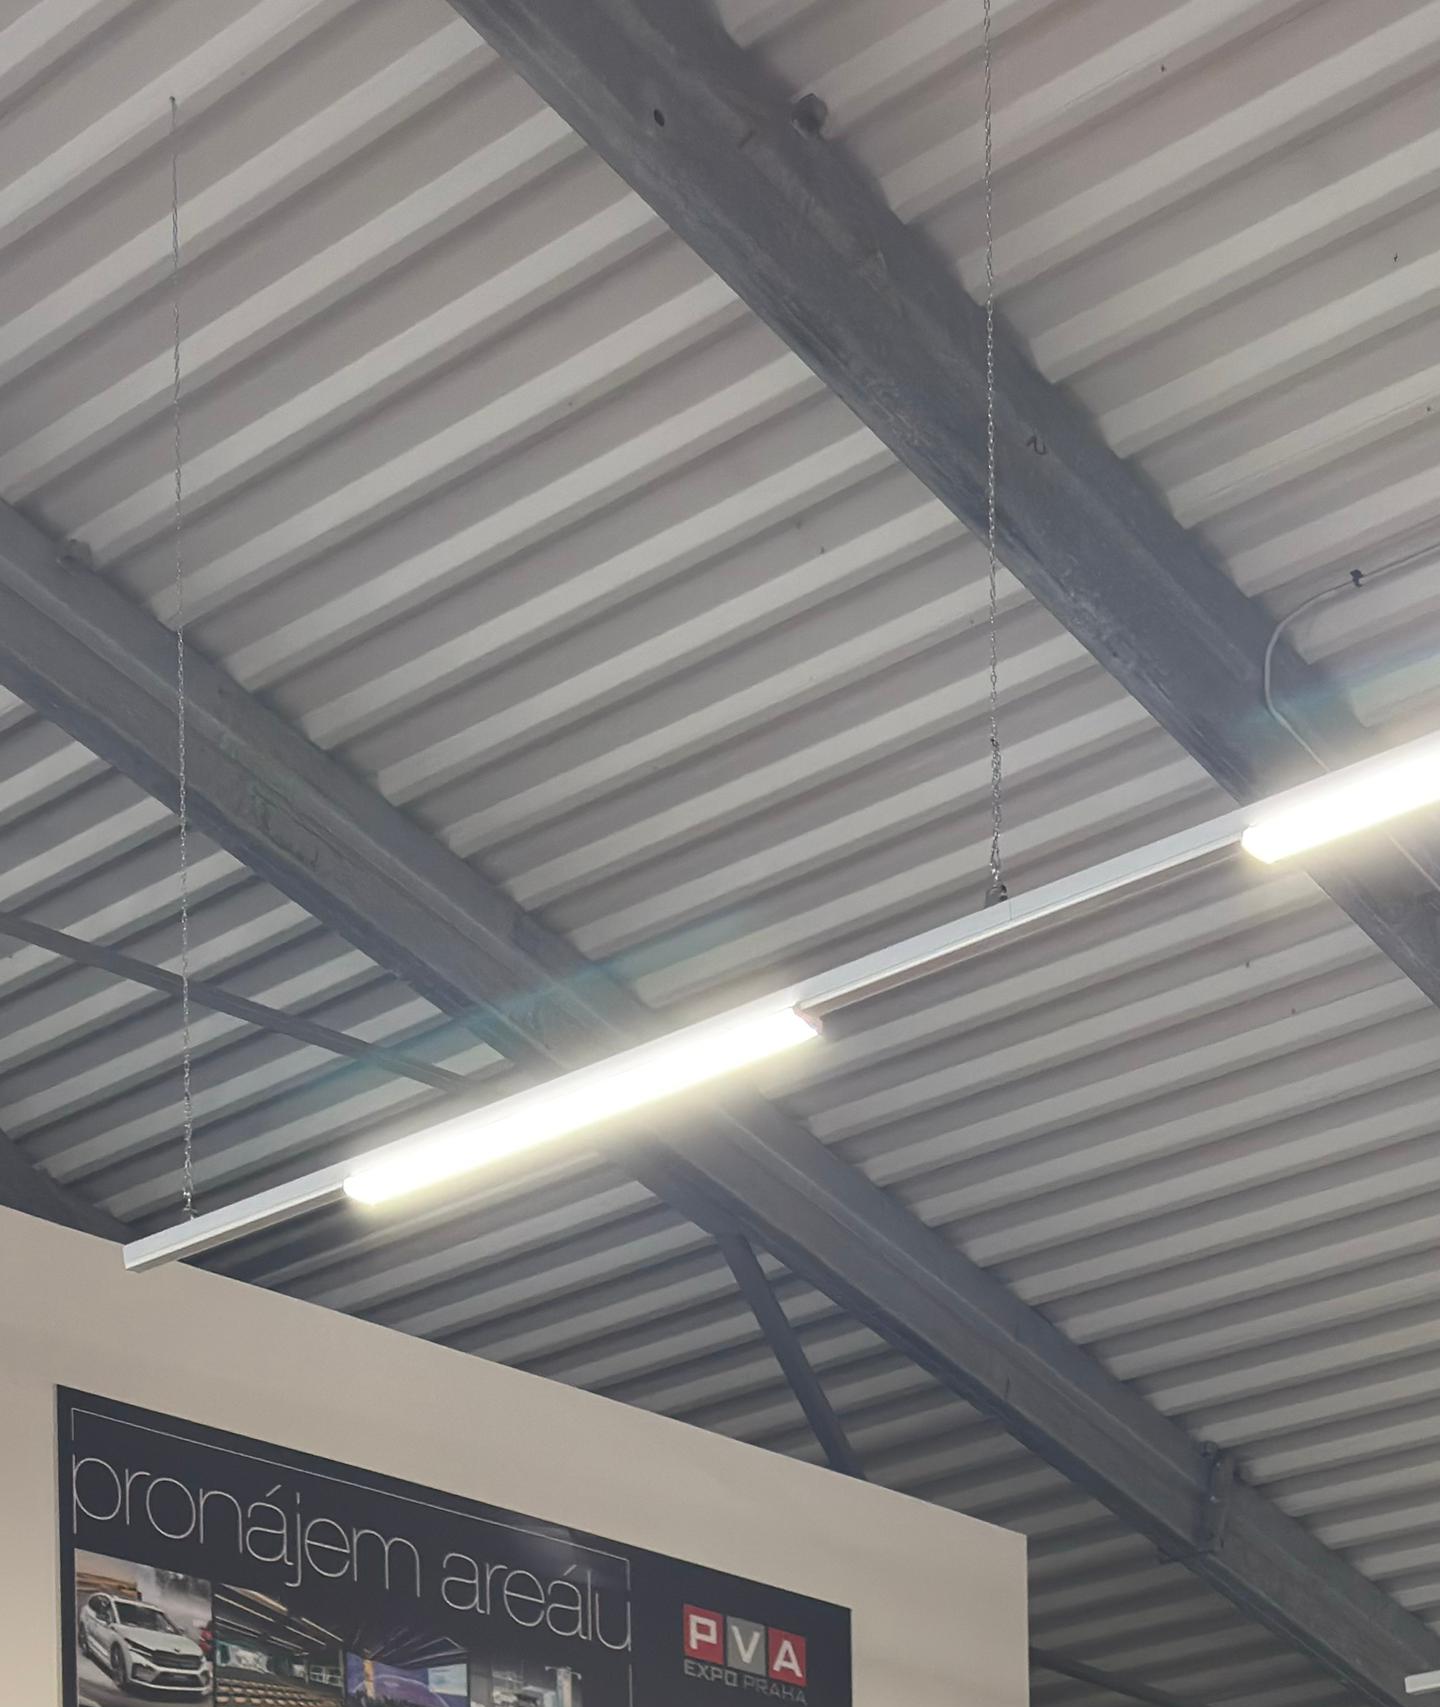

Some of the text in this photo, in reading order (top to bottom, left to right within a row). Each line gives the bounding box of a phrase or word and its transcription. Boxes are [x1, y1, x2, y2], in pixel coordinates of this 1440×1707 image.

[72, 1453, 632, 1651] pronájem areálu
[688, 1613, 803, 1678] PVA
[684, 1658, 808, 1706] EXPO PRAHA
